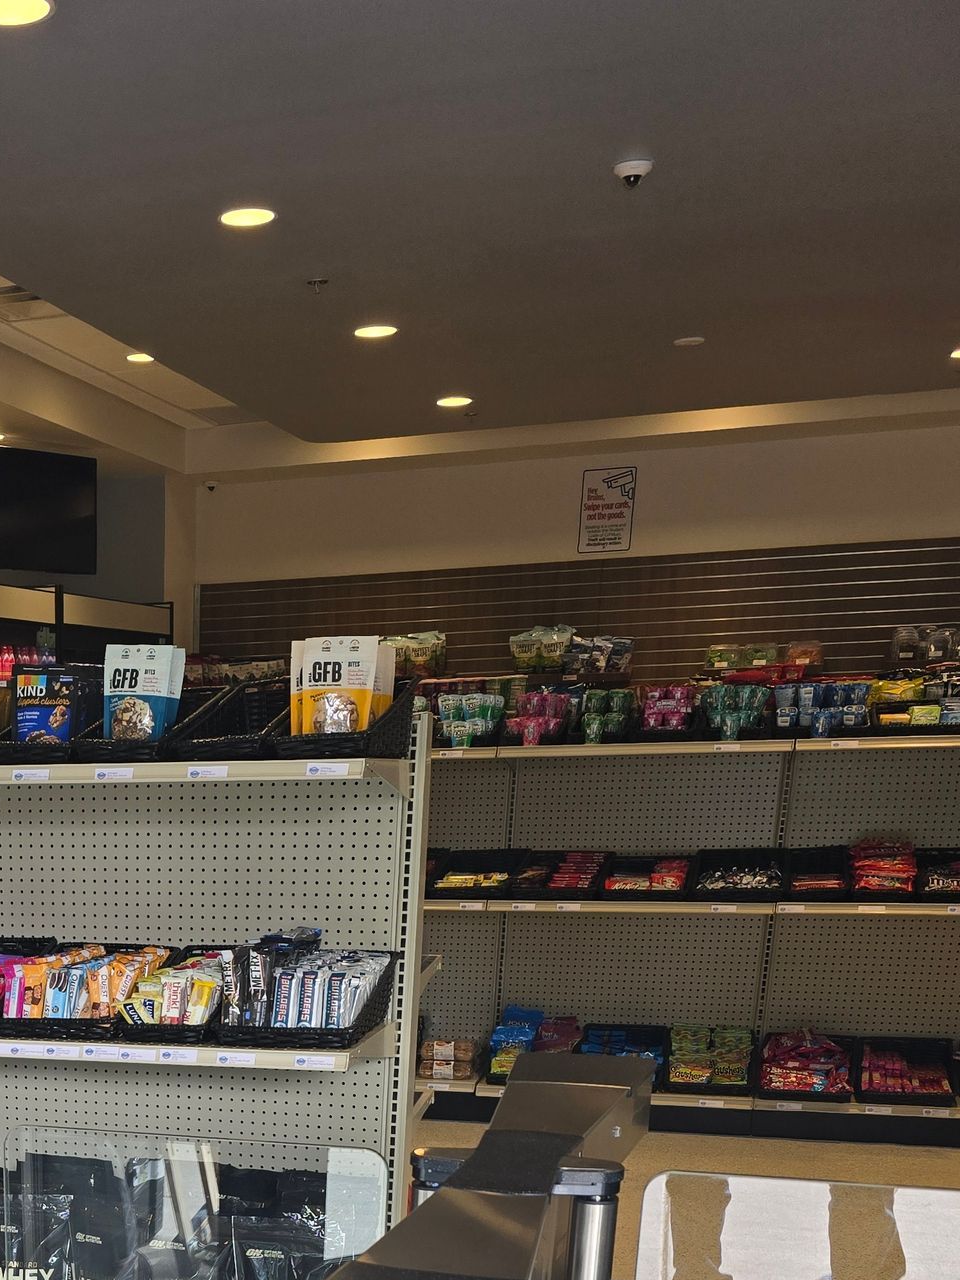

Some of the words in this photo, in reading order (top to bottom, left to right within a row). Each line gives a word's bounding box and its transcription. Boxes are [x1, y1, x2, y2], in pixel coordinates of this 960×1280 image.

[584, 503, 601, 511] Swipe
[601, 502, 614, 510] your
[586, 512, 596, 520] not
[597, 511, 607, 520] the
[112, 668, 139, 690] GFB
[312, 661, 342, 683] GFB
[17, 686, 46, 697] KIND
[41, 697, 70, 705] clusters
[277, 979, 290, 1021] BUILDERS
[301, 978, 313, 1021] BUILDERS
[328, 980, 340, 1024] BUILDERS
